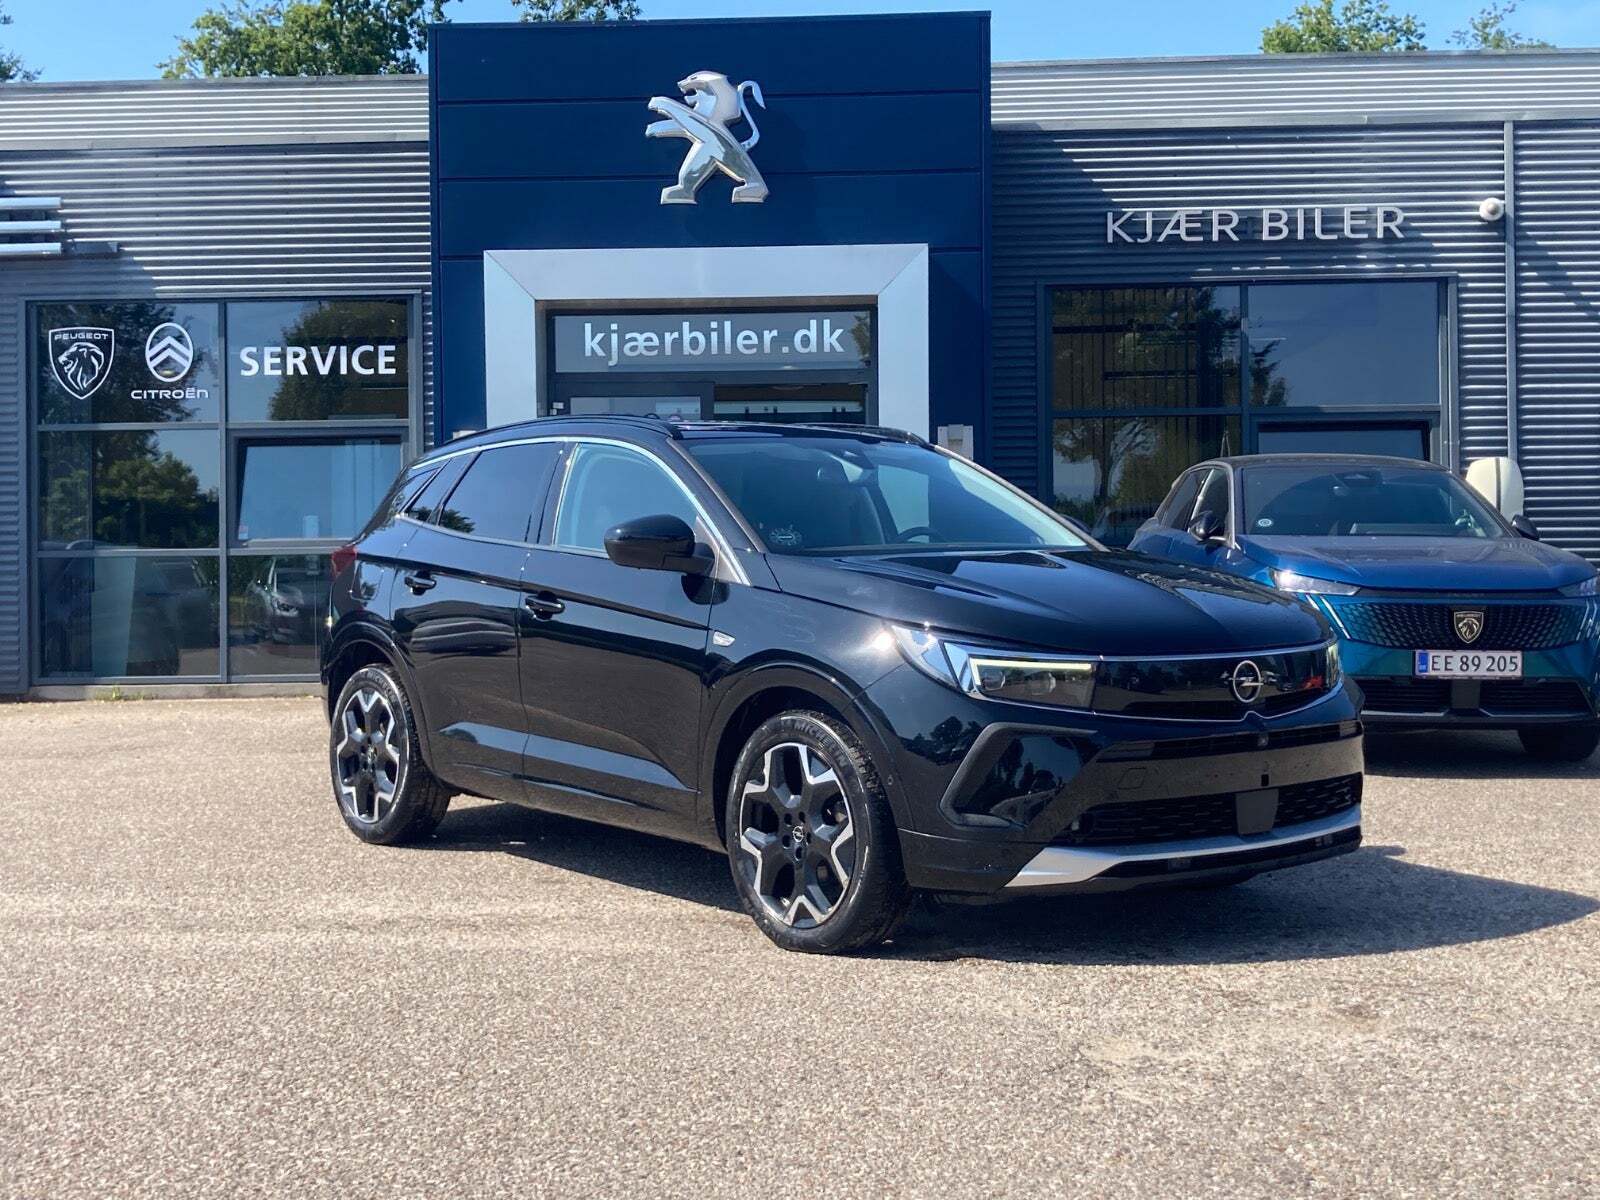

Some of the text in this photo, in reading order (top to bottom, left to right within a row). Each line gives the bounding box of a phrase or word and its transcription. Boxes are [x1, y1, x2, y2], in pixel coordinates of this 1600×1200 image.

[1106, 206, 1406, 243] KJÆR BILER
[54, 332, 109, 340] PEUGEOT
[583, 319, 845, 366] kjærbiler.dk
[239, 344, 397, 377] SERVICE
[1431, 655, 1518, 672] EE 89 205
